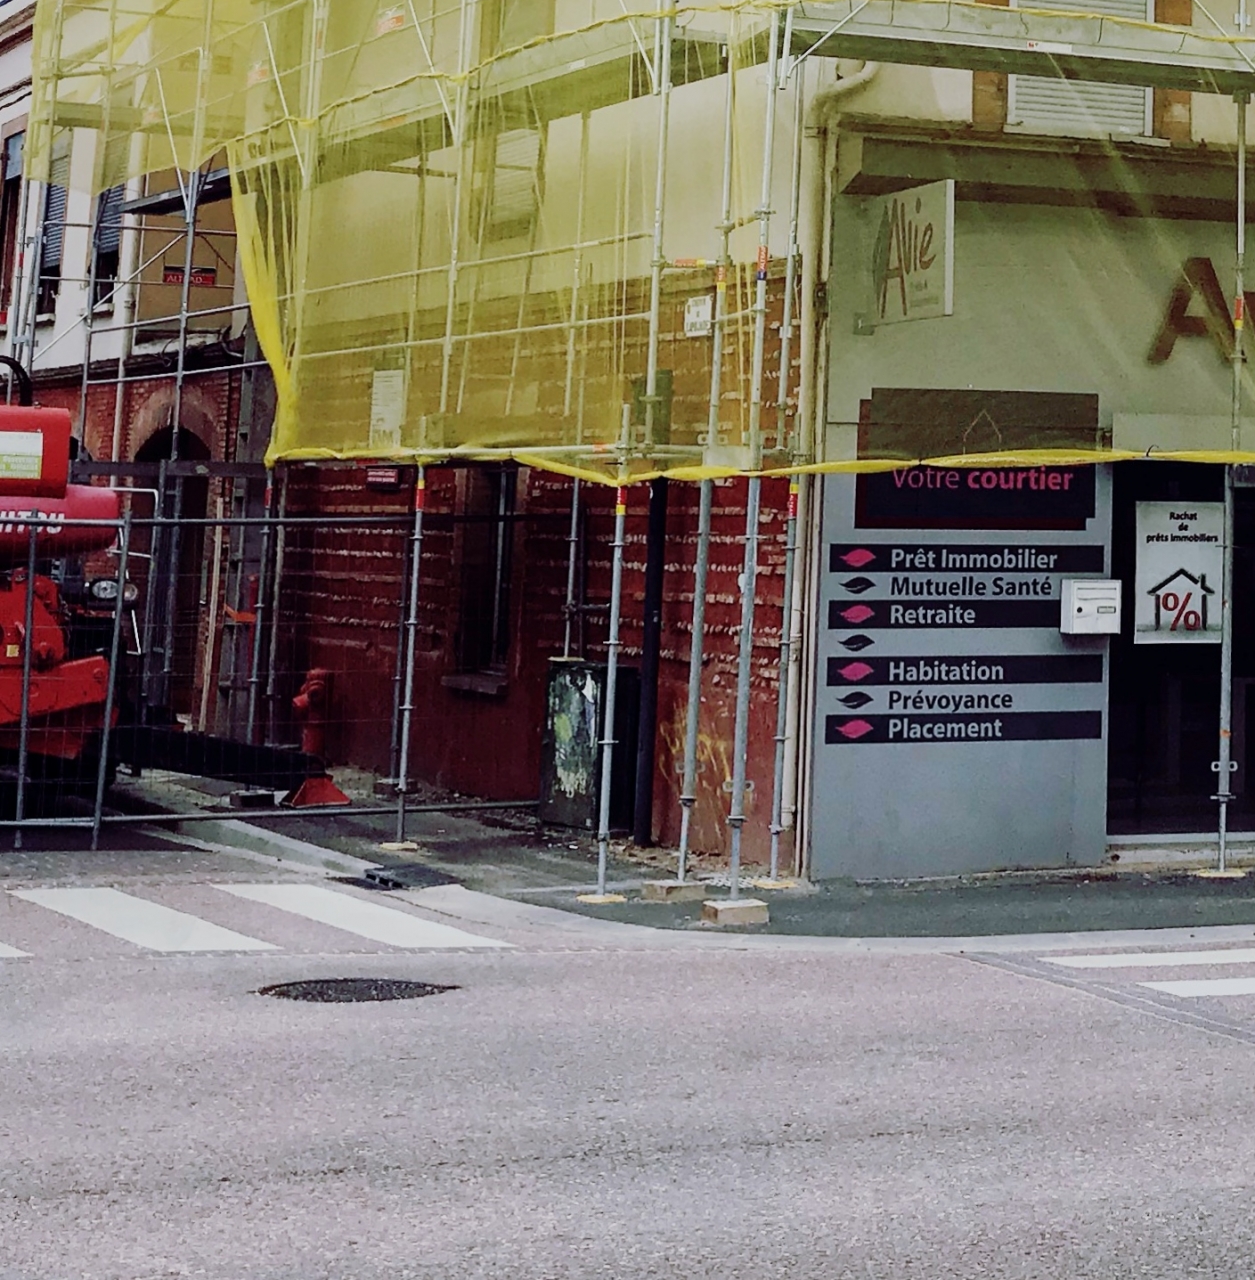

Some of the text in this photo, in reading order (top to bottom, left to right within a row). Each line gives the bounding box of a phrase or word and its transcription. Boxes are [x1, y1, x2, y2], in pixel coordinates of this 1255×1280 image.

[167, 275, 203, 284] ALTAD
[893, 464, 1073, 491] Votre courtier
[1169, 511, 1198, 521] Rachat
[1178, 522, 1189, 531] de
[891, 548, 1058, 569] Prêt Immobilier
[890, 576, 1052, 597] Mutuelle Santé
[890, 604, 976, 624] Retraite
[889, 660, 1004, 682] Habitation
[888, 689, 1013, 713] Prévoyance
[888, 718, 1003, 739] Placement
